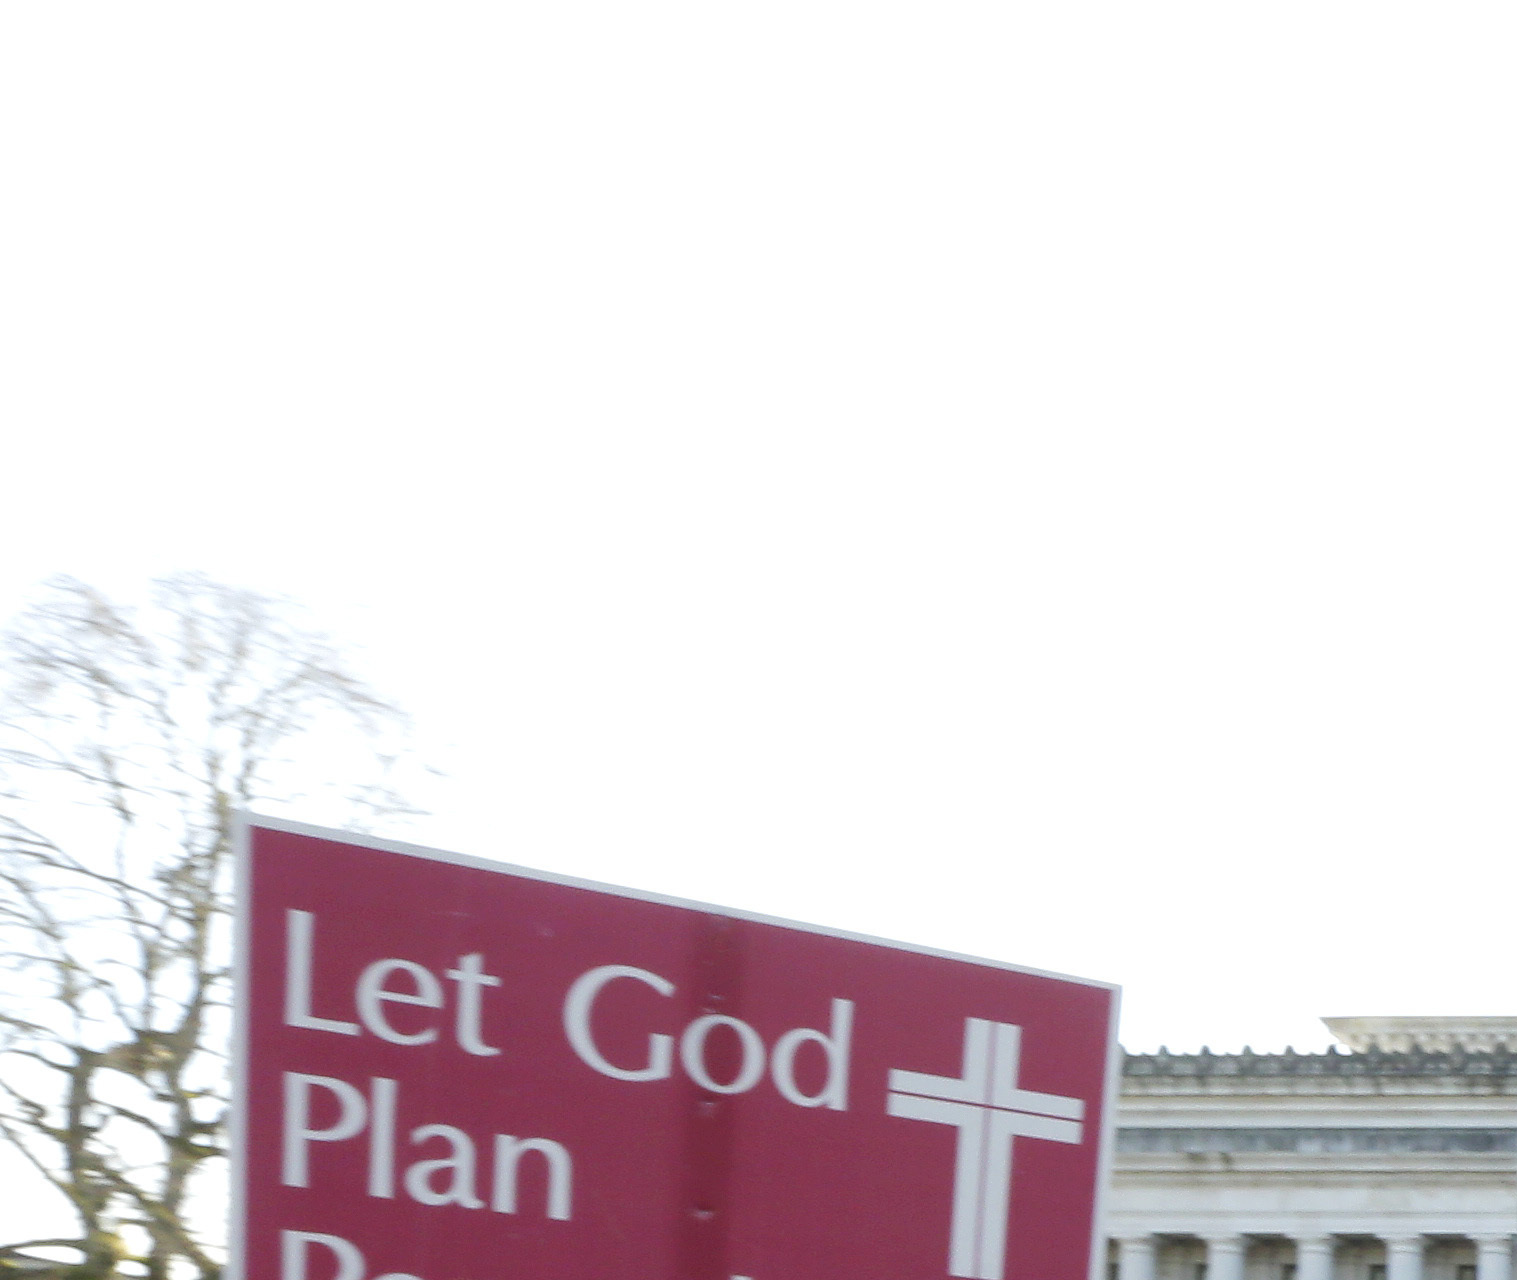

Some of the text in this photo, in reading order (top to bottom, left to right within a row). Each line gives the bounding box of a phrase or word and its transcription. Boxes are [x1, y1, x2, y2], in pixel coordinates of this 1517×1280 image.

[285, 908, 855, 1113] Let God
[282, 1071, 572, 1221] Plan
